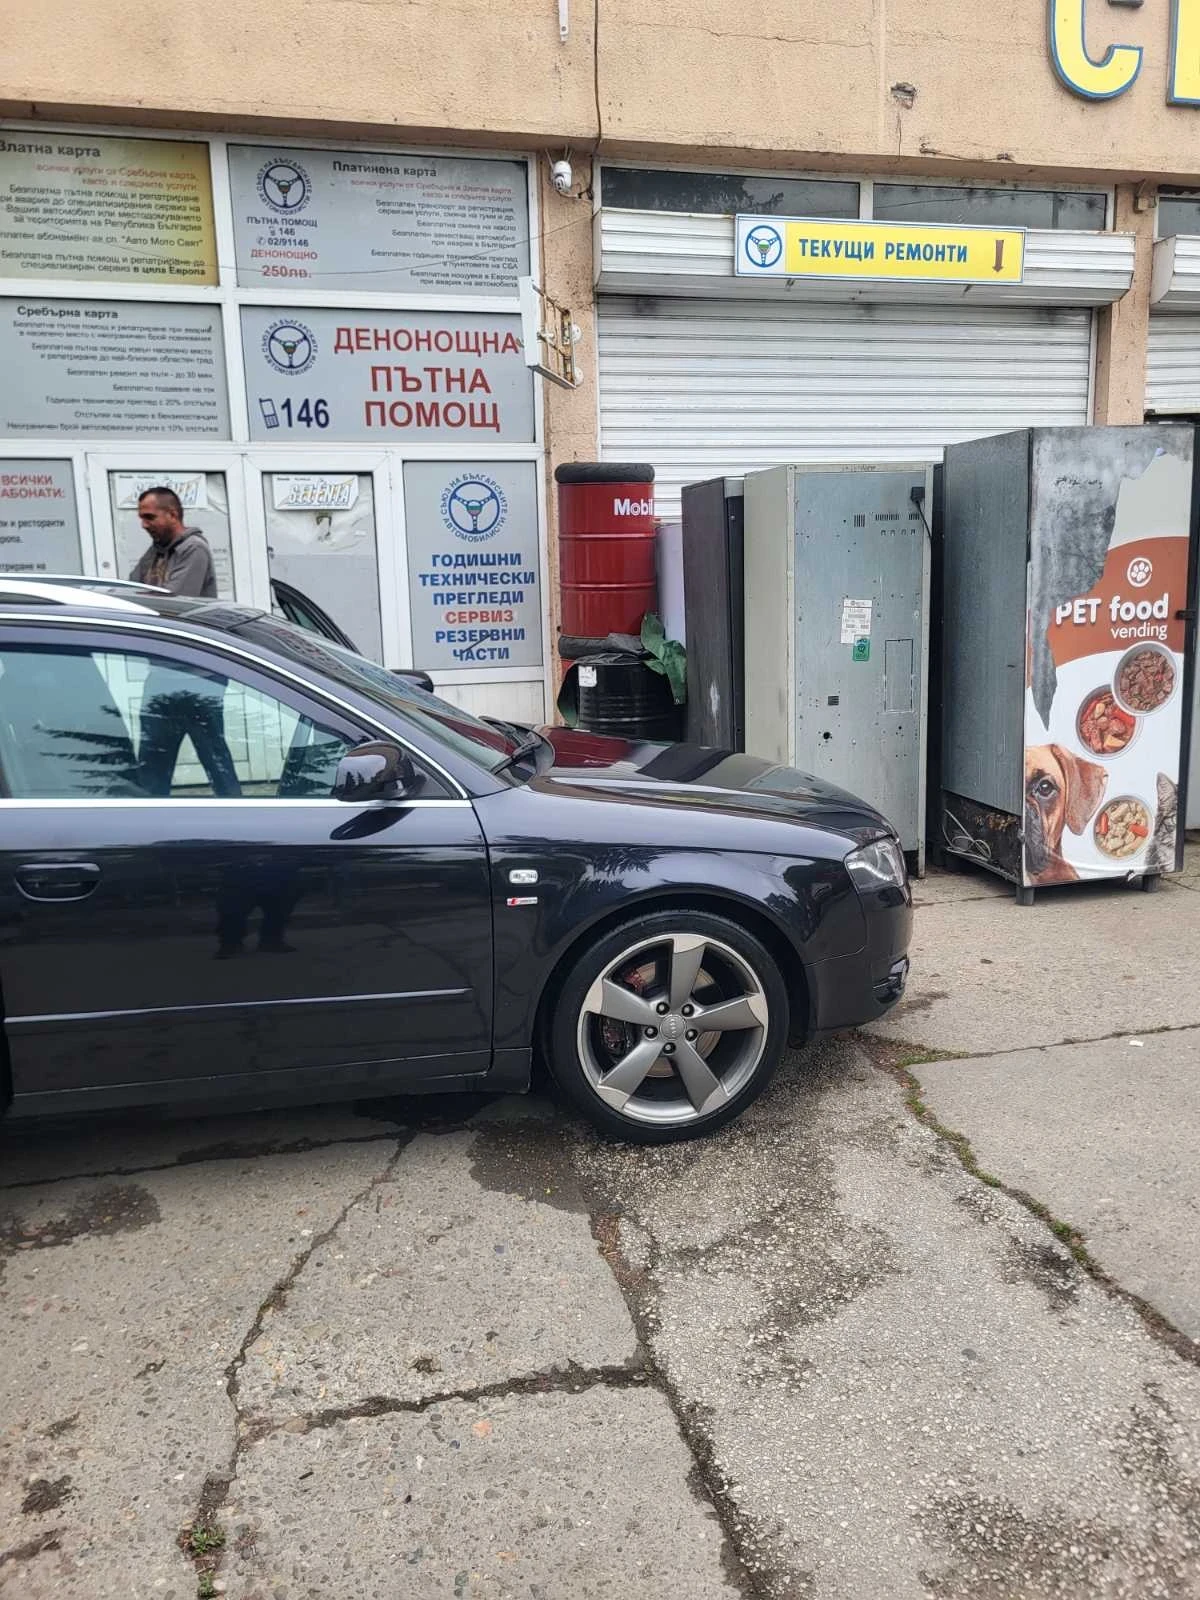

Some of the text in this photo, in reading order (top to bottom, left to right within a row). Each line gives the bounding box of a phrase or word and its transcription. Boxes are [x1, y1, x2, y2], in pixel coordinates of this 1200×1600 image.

[58, 146, 101, 158] карта
[333, 160, 437, 178] Платинена карта
[10, 184, 61, 195] Безплатна
[64, 188, 93, 197] пътна
[95, 190, 128, 199] помощ
[139, 193, 199, 203] репатриране
[105, 218, 155, 230] Република
[158, 221, 202, 232] България
[247, 216, 318, 227] ПЪТНА ПОМОЩ
[279, 228, 296, 236] 146
[150, 237, 175, 247] Мото
[267, 237, 309, 247] 02/91146
[251, 249, 318, 260] ДЕНОНОЩНО
[799, 238, 968, 263] ТЕКУЩИ РЕМОНТИ
[169, 266, 205, 277] Европа
[262, 264, 312, 278] 250лв.
[17, 305, 119, 320] Сребърна карта
[334, 327, 519, 357] ДЕНОНОЩНА
[370, 365, 491, 394] ПЪТНА
[281, 398, 330, 429] 146
[365, 401, 500, 433] ПОМОЩ
[1, 474, 53, 486] ВСИЧКИ
[440, 473, 508, 515] СЪЮЗ НА БЪЛГАРСКИТЕ
[613, 498, 653, 516] Mobil
[442, 515, 506, 543] АВТОМОБИЛИСТИ
[432, 552, 522, 569] ГОДИШНИ
[419, 571, 535, 587] ТЕХНИЧЕСКИ
[433, 590, 524, 606] ПРЕГЛЕДИ
[445, 609, 514, 624] СЕРВИЗ
[1055, 593, 1169, 626] PET food
[435, 628, 525, 643] РЕЗЕРВНИ
[1110, 621, 1168, 640] vending
[452, 647, 510, 662] ЧАСТИ
